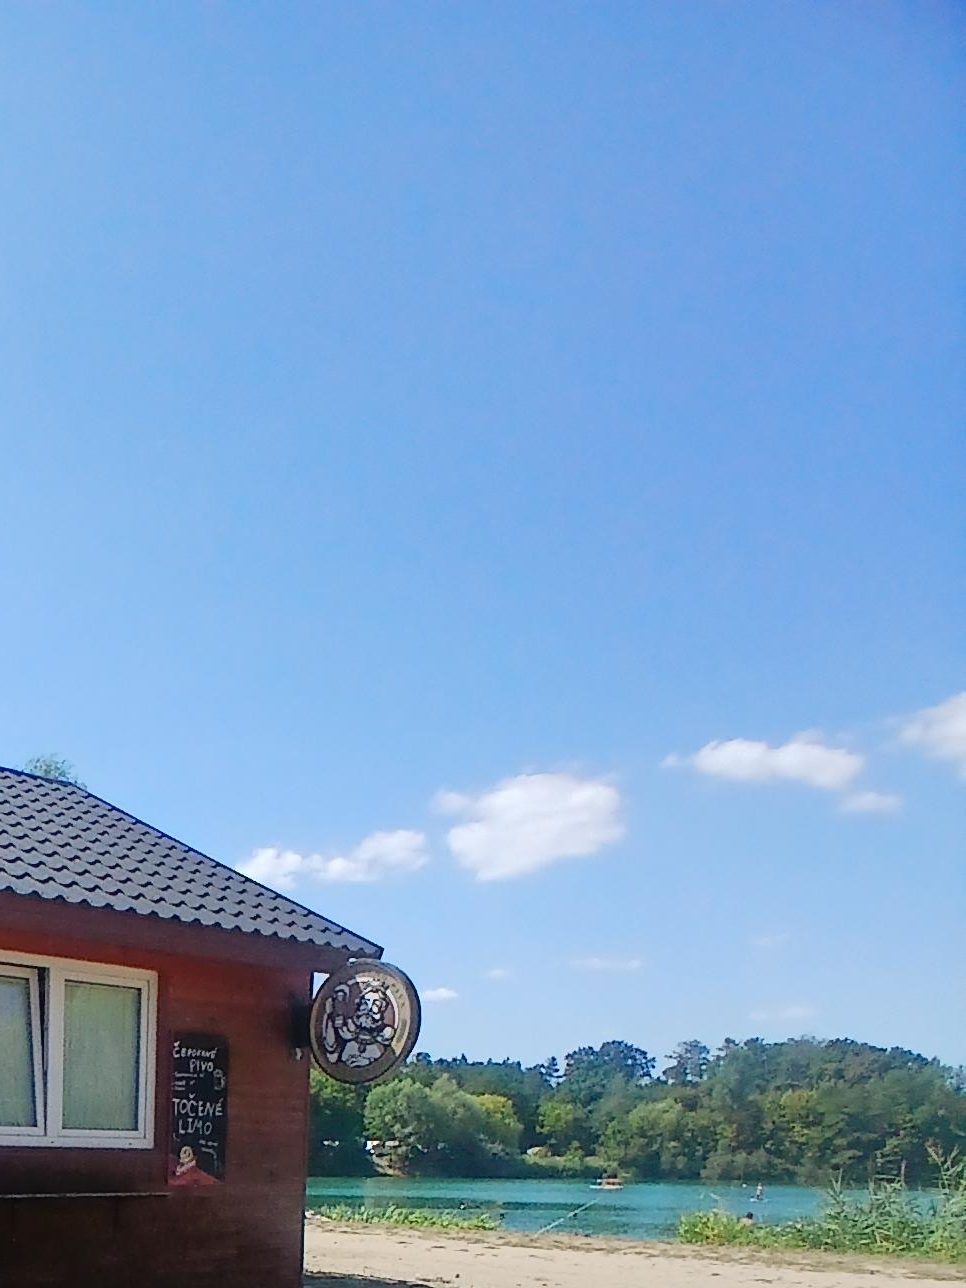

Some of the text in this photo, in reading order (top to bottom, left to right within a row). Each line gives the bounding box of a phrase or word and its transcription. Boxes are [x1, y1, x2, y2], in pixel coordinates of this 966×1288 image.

[189, 1058, 214, 1073] PIVO
[172, 1093, 224, 1117] TOČENÉ
[178, 1117, 213, 1135] LIMO
